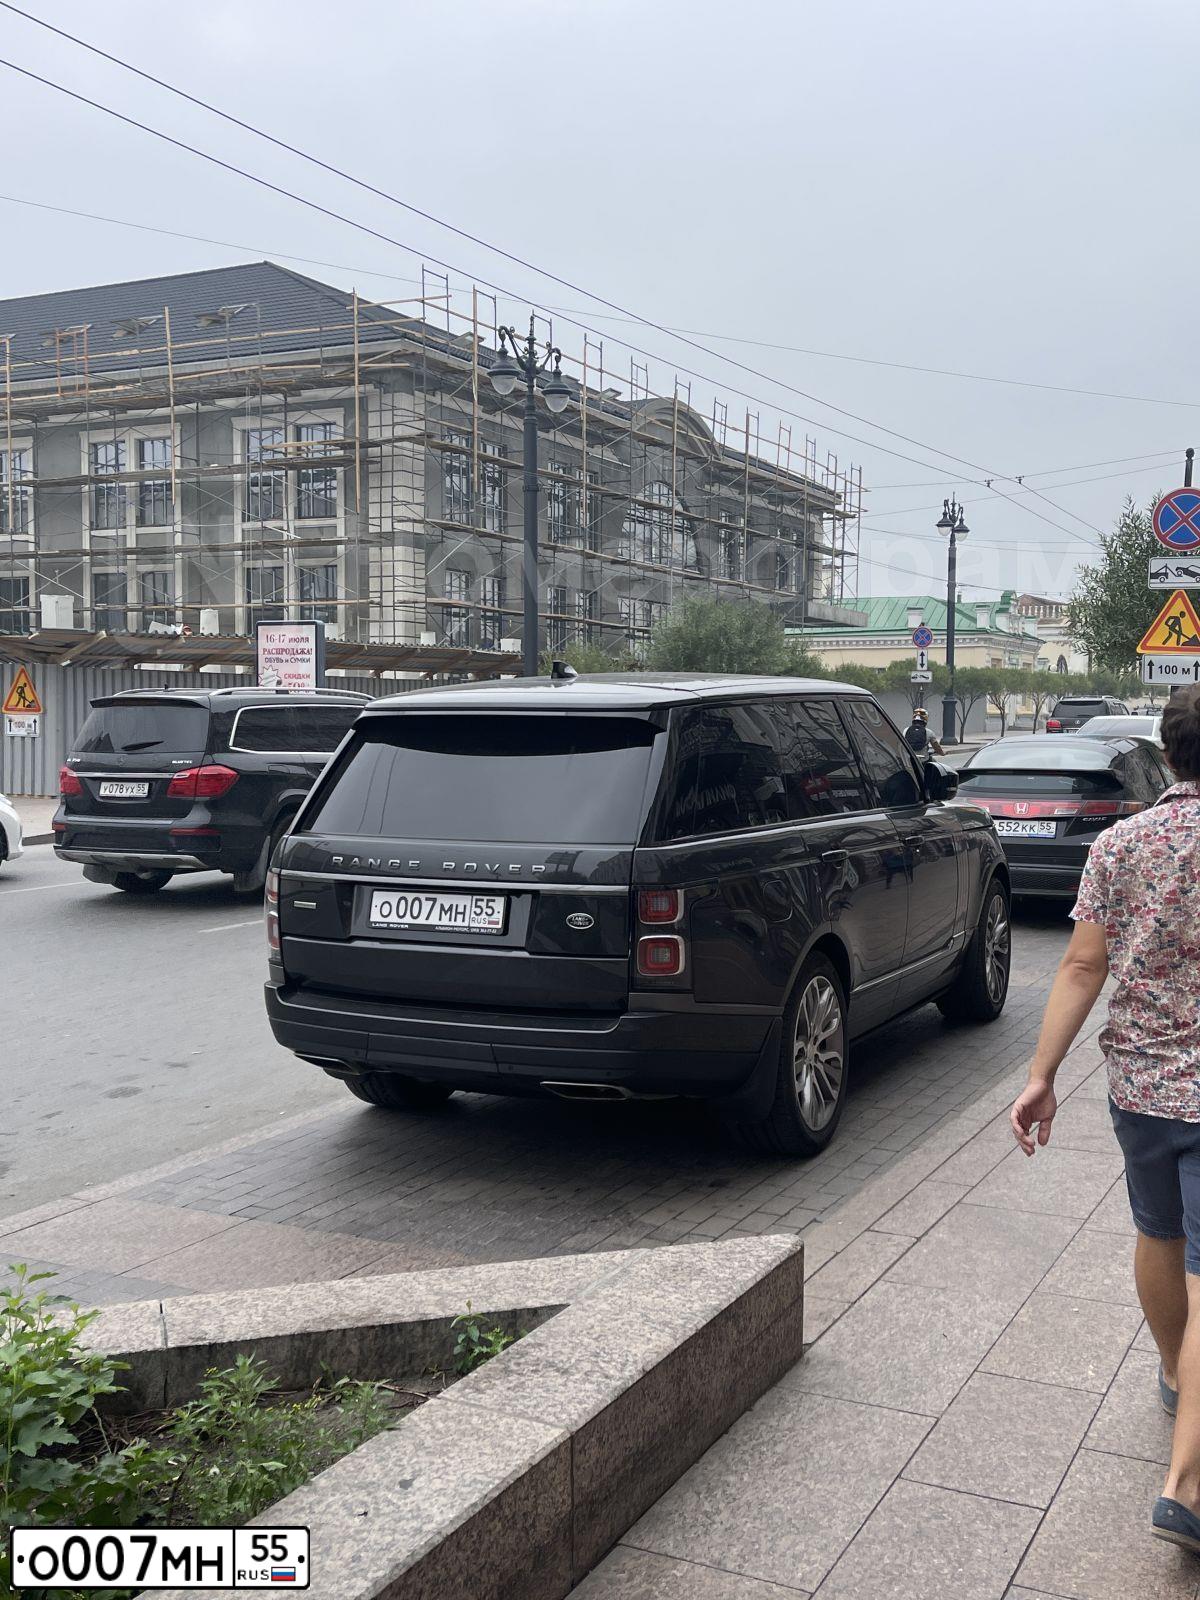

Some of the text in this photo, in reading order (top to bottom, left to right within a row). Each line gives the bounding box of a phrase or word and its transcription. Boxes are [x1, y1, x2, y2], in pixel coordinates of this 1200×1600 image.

[266, 634, 286, 643] 16-17
[262, 648, 313, 656] РАСПРОДАЖА!
[1158, 664, 1178, 675] 100
[1040, 821, 1052, 830] 55
[332, 856, 546, 874] RANGE ROVER
[473, 898, 496, 916] 55
[471, 917, 487, 925] RUS
